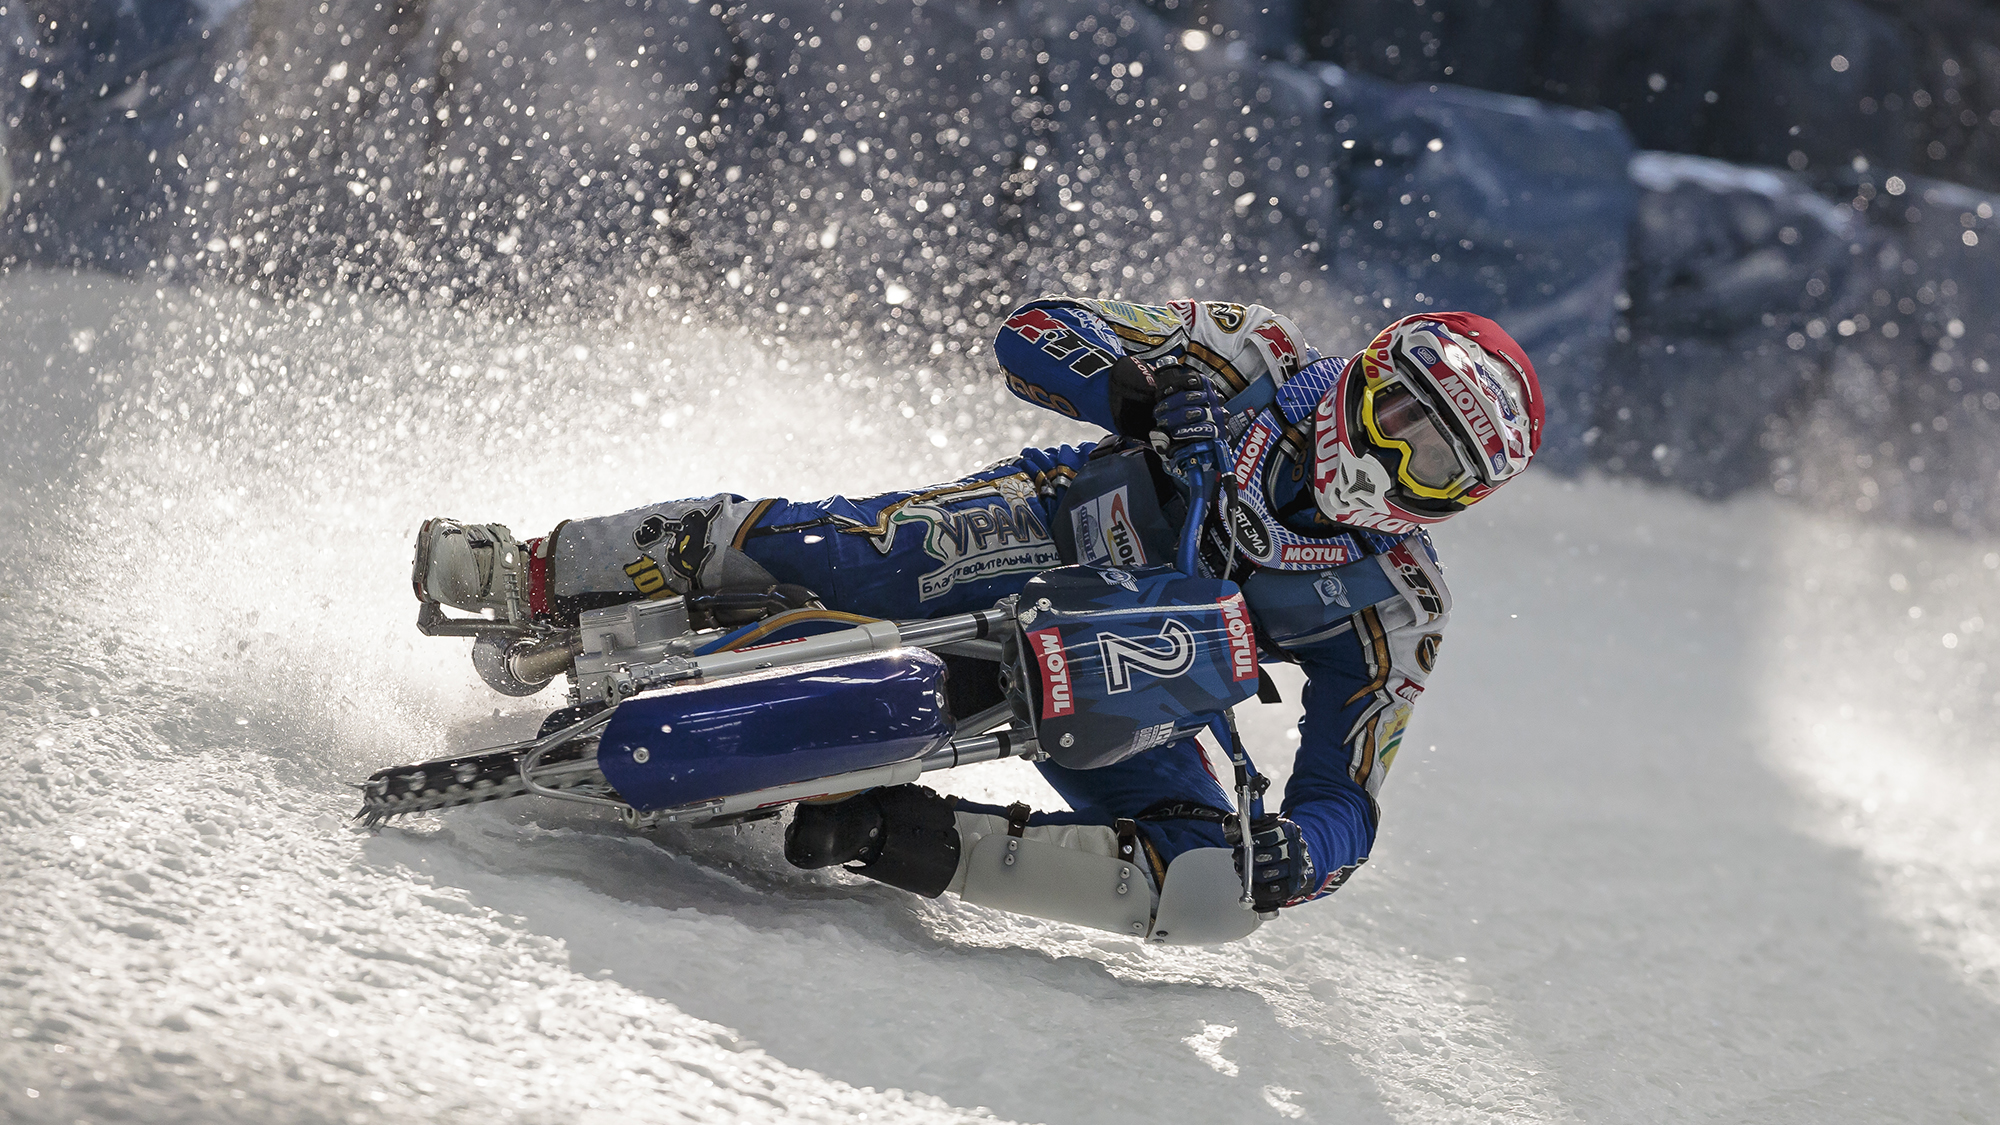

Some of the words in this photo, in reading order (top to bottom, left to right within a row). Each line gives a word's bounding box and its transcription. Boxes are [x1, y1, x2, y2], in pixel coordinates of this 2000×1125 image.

[1315, 400, 1340, 480] OTUL
[1440, 377, 1495, 446] MOTUL
[934, 504, 1049, 556] УРАЛ
[1284, 547, 1344, 562] MOTUL
[922, 553, 1032, 594] Благтворительный
[1322, 578, 1338, 598] FIM
[1039, 633, 1071, 713] MOTUL
[1097, 618, 1196, 695] 2
[1220, 599, 1253, 678] MOTUL
